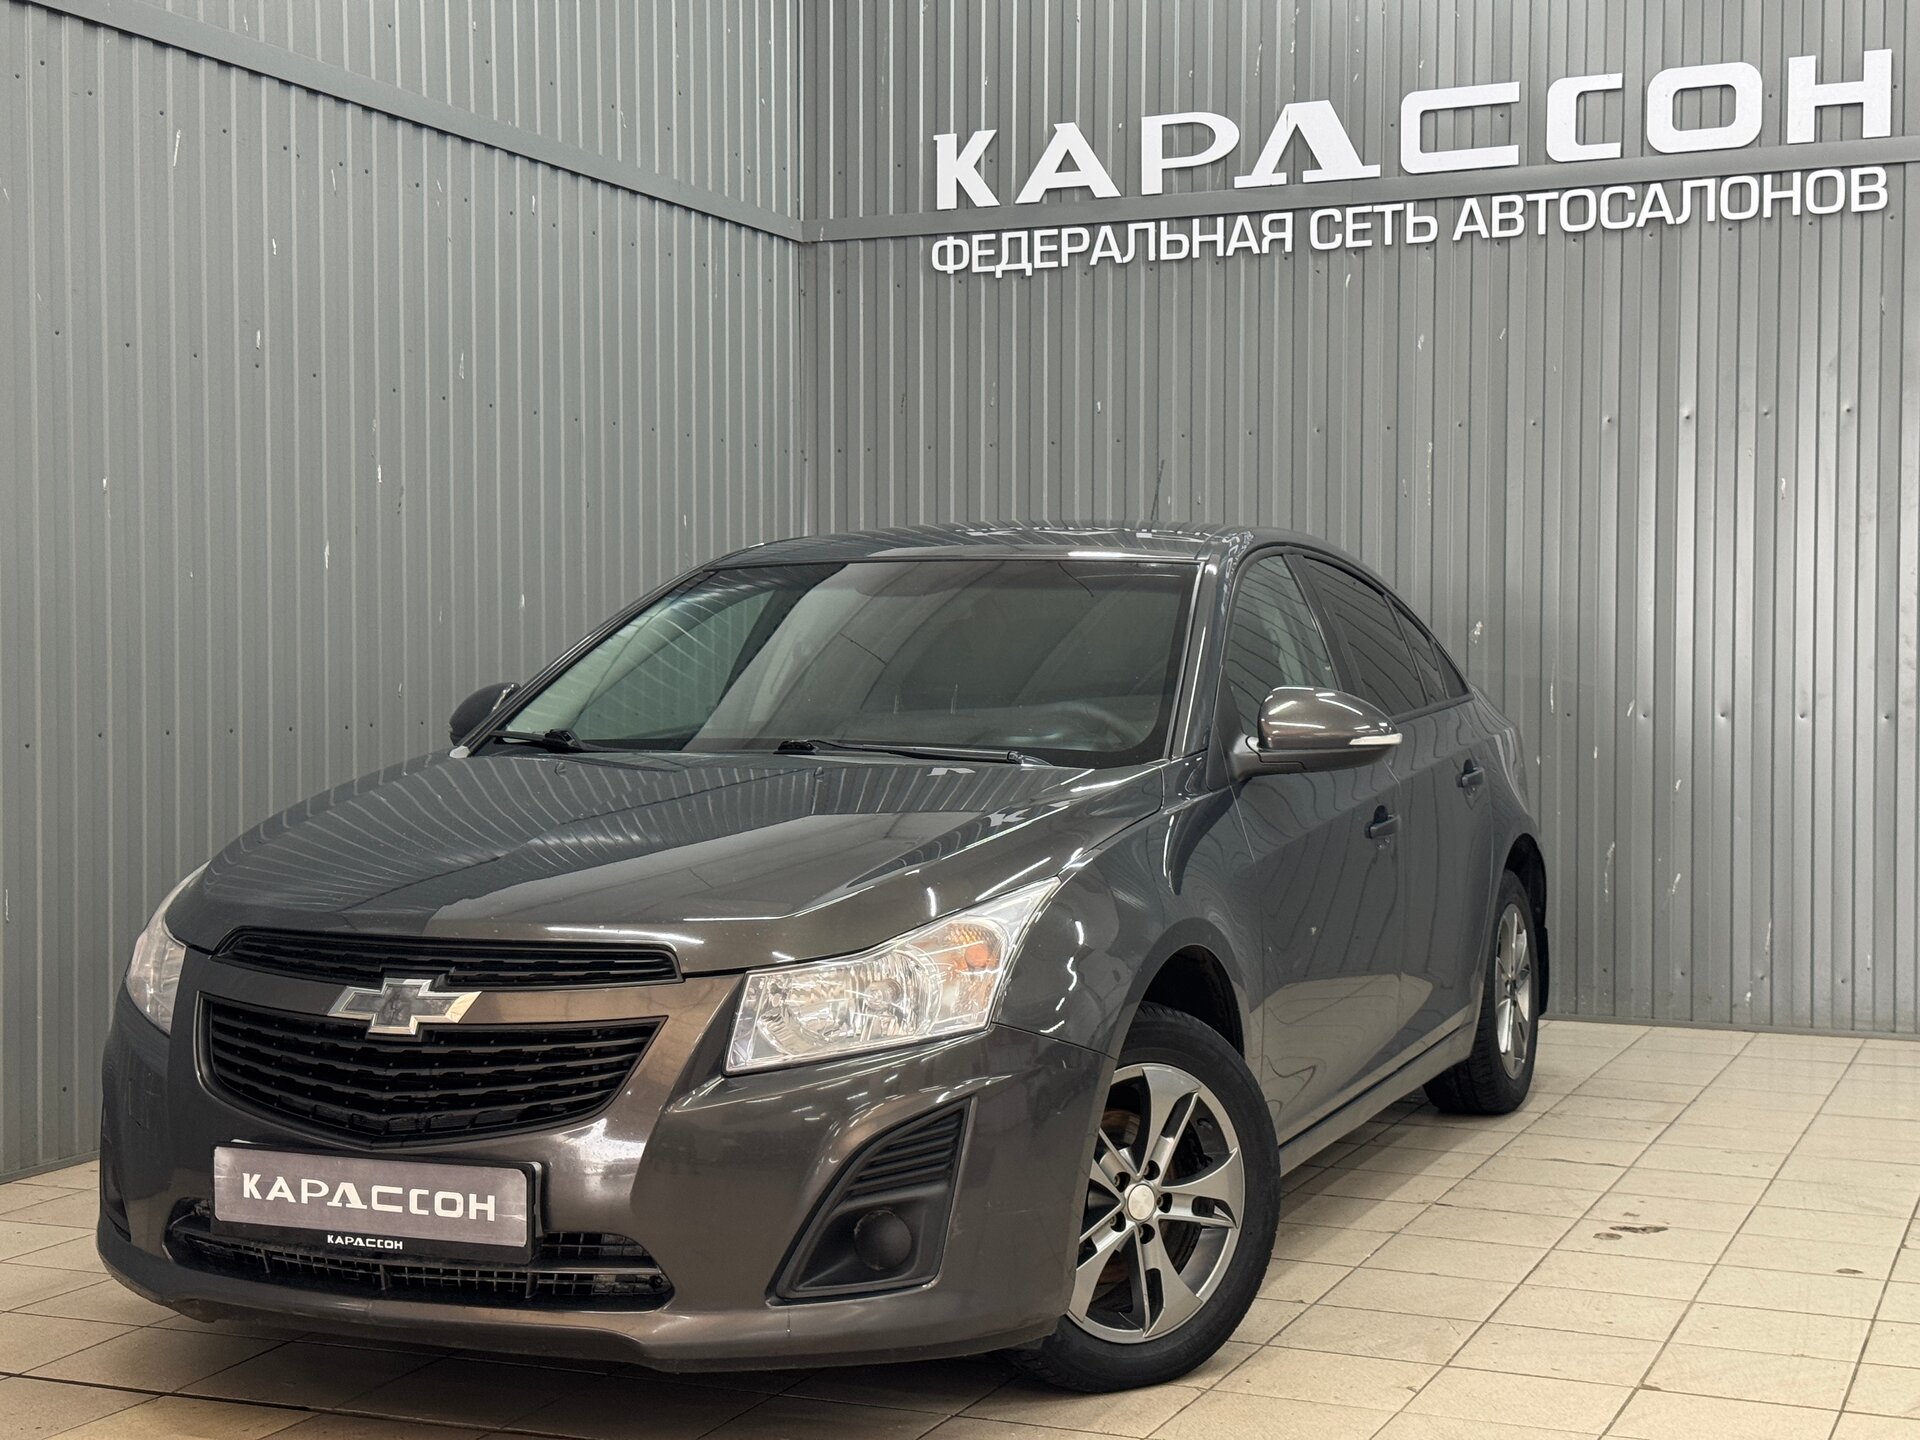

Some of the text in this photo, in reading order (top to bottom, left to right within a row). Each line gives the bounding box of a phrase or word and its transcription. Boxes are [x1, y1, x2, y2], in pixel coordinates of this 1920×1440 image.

[931, 165, 1889, 279] ФЕДЕРАЛЬНАЯ СЕТЬ АВТОСАЛОНОВ
